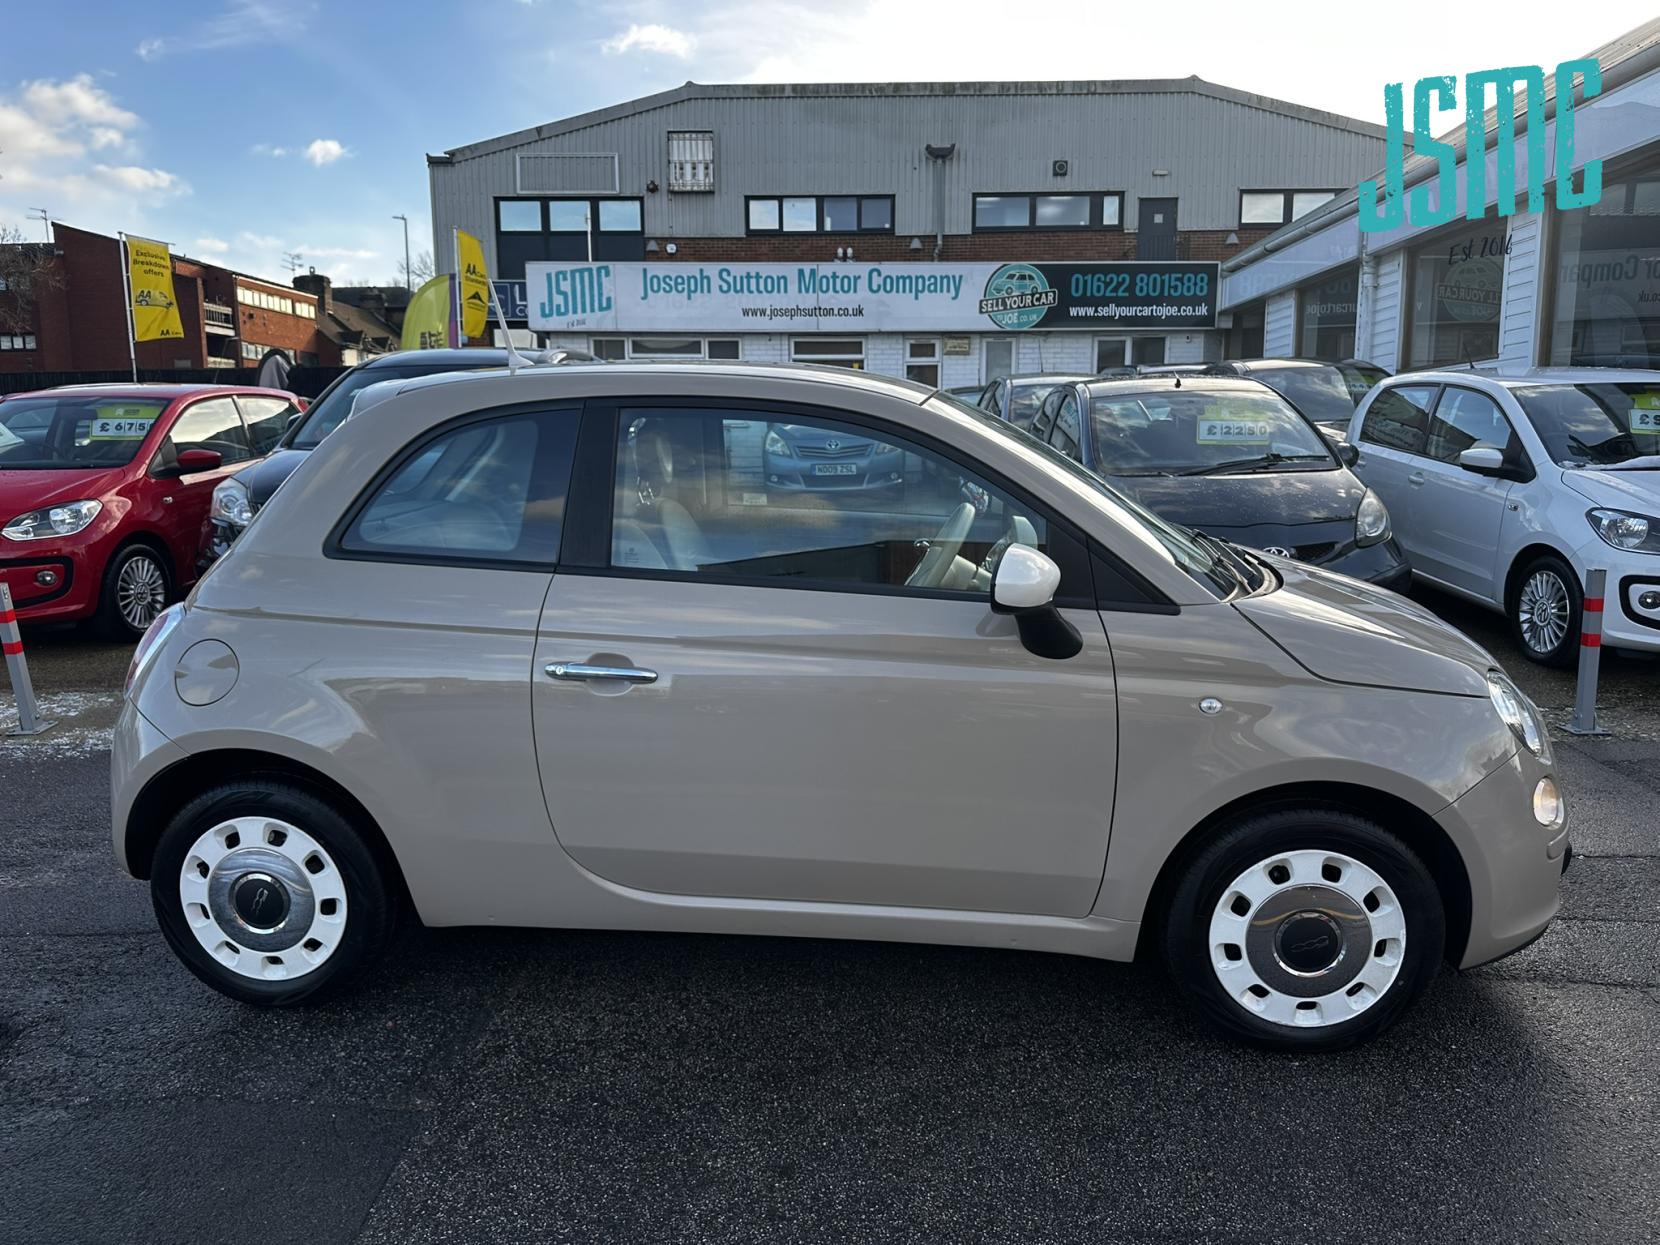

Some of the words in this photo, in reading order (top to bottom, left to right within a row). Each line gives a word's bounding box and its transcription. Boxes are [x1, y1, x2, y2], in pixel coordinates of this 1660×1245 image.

[135, 249, 166, 261] Exclusive
[133, 258, 170, 270] Breakdown
[143, 268, 164, 278] offers
[641, 267, 711, 301] Joseph
[718, 267, 788, 294] Sutton
[797, 267, 861, 294] Motor
[868, 267, 963, 301] Company
[1071, 273, 1130, 297] 01622
[1135, 273, 1208, 297] 801588
[138, 289, 151, 300] AA
[540, 265, 612, 318] JSMC
[981, 299, 1004, 312] SELL
[1006, 295, 1032, 309] YOUR
[1033, 292, 1055, 306] CAR
[742, 304, 865, 320] www.josephsutton.co.uk
[1069, 303, 1208, 320] www.sellyourcartojoe.co.uk
[1002, 313, 1018, 324] JOE
[160, 328, 170, 336] AA
[100, 422, 154, 433] £675
